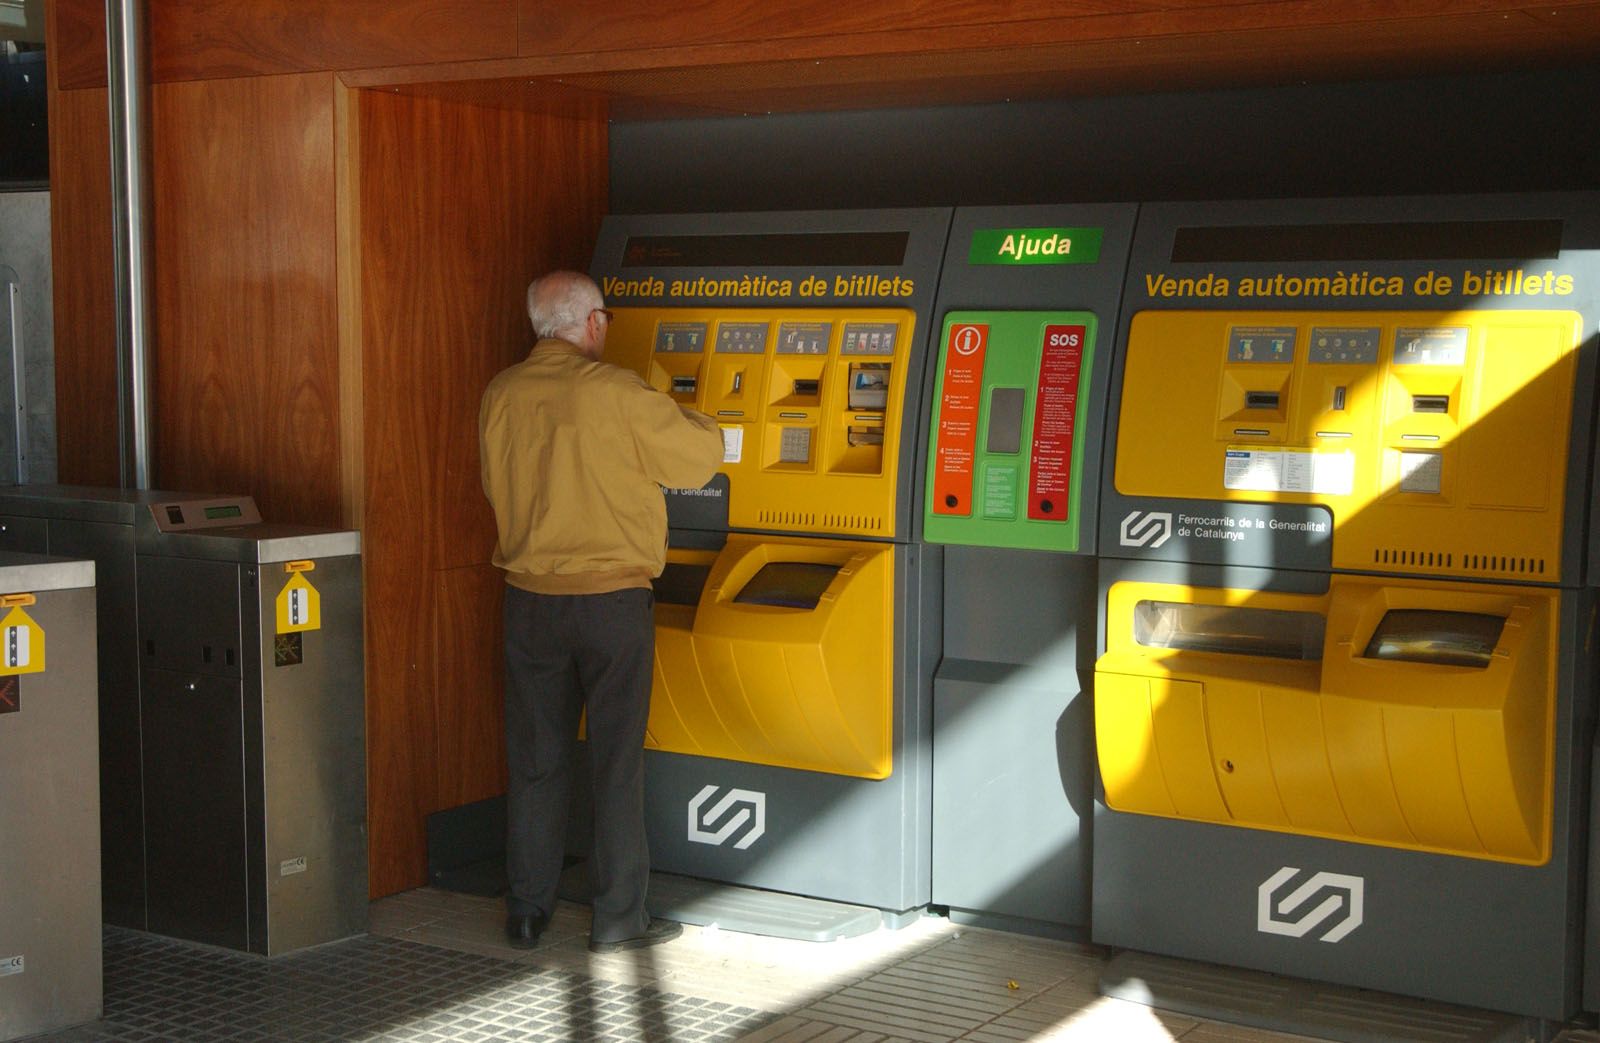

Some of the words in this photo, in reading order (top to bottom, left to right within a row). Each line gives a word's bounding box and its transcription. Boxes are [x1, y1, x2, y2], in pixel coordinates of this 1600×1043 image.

[998, 234, 1072, 260] Ajuda
[602, 277, 664, 296] Venda
[670, 275, 793, 297] automàtica
[799, 275, 826, 297] de
[833, 274, 915, 297] bitllets
[1145, 274, 1229, 297] Venda
[1238, 271, 1403, 296] automàtica
[1414, 271, 1452, 295] de
[1462, 270, 1574, 296] bitllets
[1049, 333, 1079, 347] SOS
[681, 487, 722, 497] Generalitat
[1178, 514, 1235, 527] Ferrocarrils
[1239, 517, 1253, 528] de
[1256, 518, 1265, 529] la
[1269, 519, 1326, 532] Generalitat
[1178, 526, 1190, 536] de
[1195, 527, 1245, 541] Catalunya
